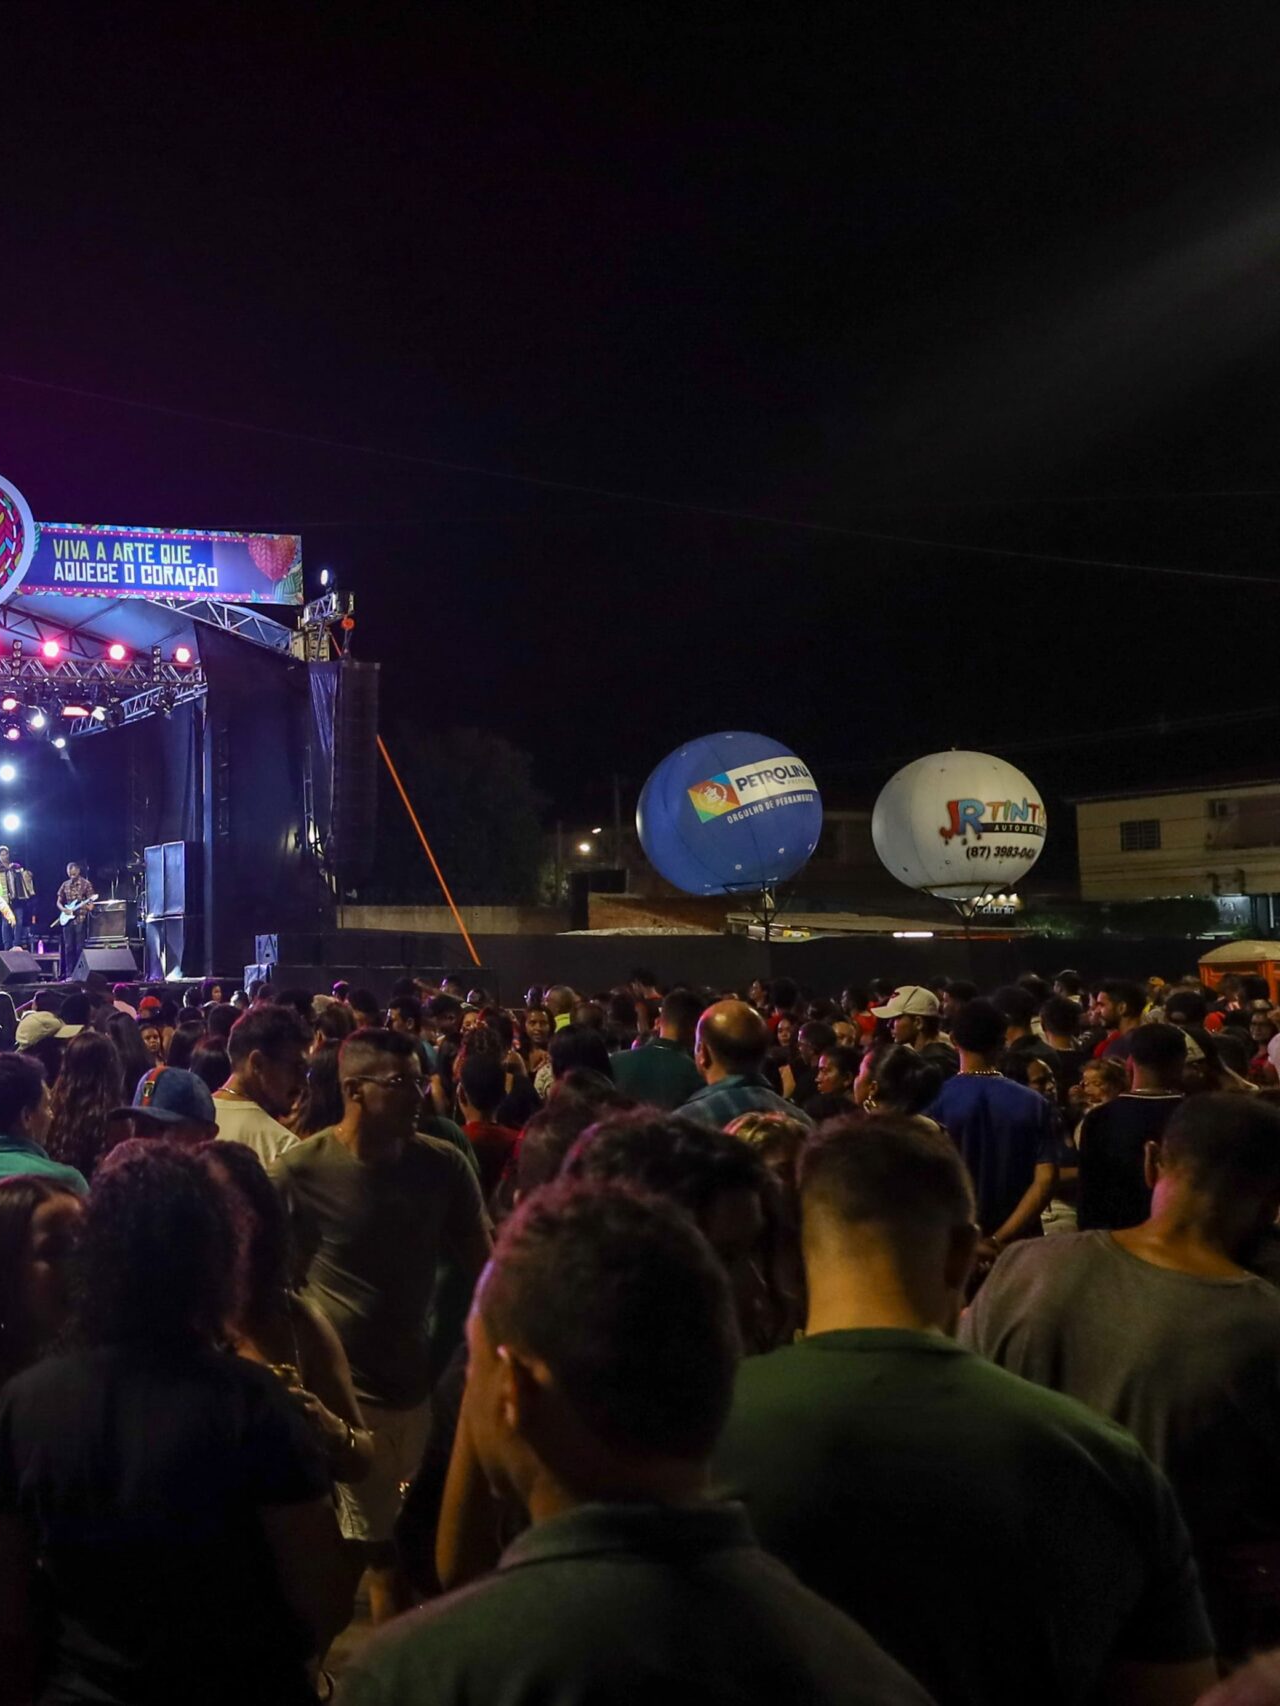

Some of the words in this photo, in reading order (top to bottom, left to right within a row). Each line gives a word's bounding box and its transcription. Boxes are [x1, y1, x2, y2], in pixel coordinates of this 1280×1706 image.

[53, 538, 90, 560] VIVA
[96, 541, 107, 561] A
[113, 542, 155, 564] ARTE
[160, 543, 193, 565] QUE
[54, 561, 119, 584] AQUECE
[124, 564, 135, 584] O
[140, 563, 219, 592] CORAÇÃO
[734, 764, 811, 792] PETROLINA
[726, 804, 764, 825] ORGULHO
[765, 800, 774, 811] DE
[939, 798, 986, 841] JR
[965, 845, 991, 860] (87)
